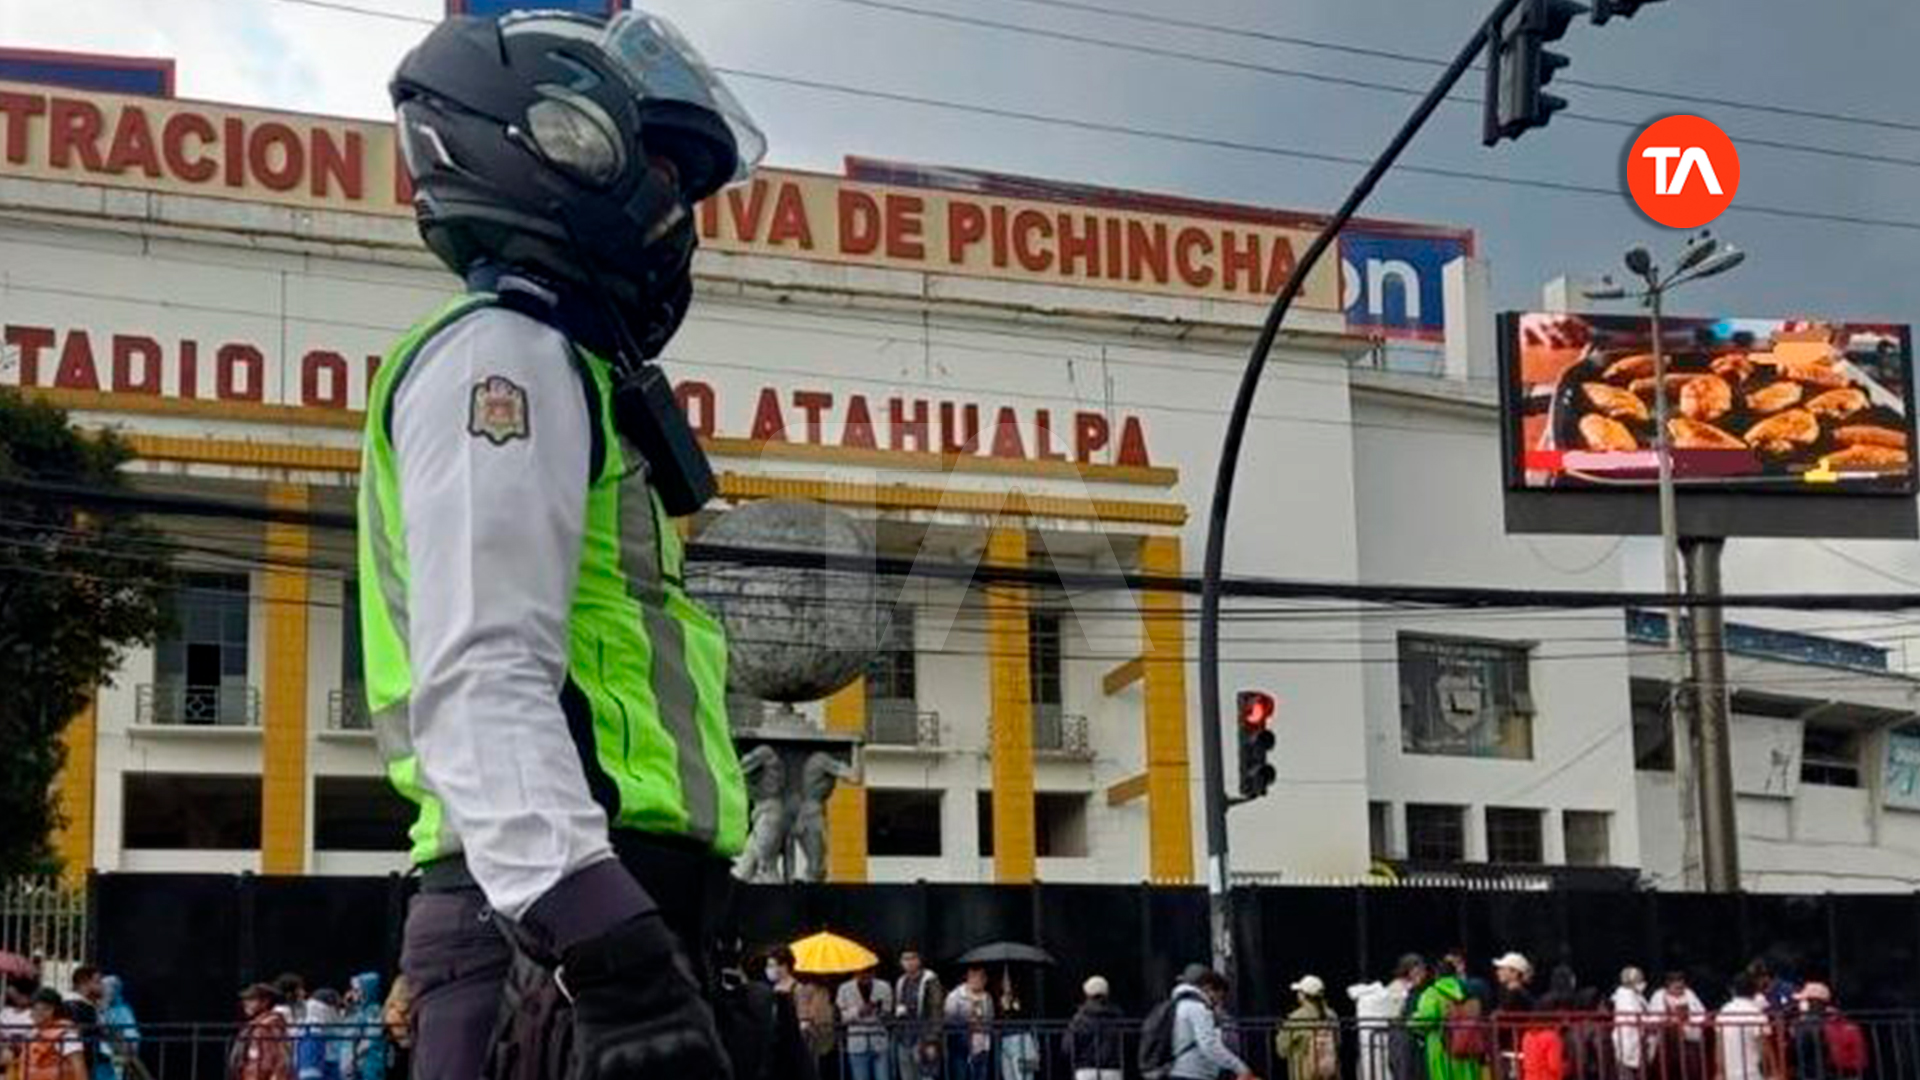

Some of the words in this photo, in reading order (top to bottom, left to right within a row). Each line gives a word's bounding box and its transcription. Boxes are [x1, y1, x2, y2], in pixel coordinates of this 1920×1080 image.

[0, 91, 364, 201] TRACION
[838, 189, 924, 260] DE
[947, 201, 1304, 297] PICHINCHA
[4, 324, 265, 403] TADIO
[751, 387, 1150, 467] ATAHUALPA
